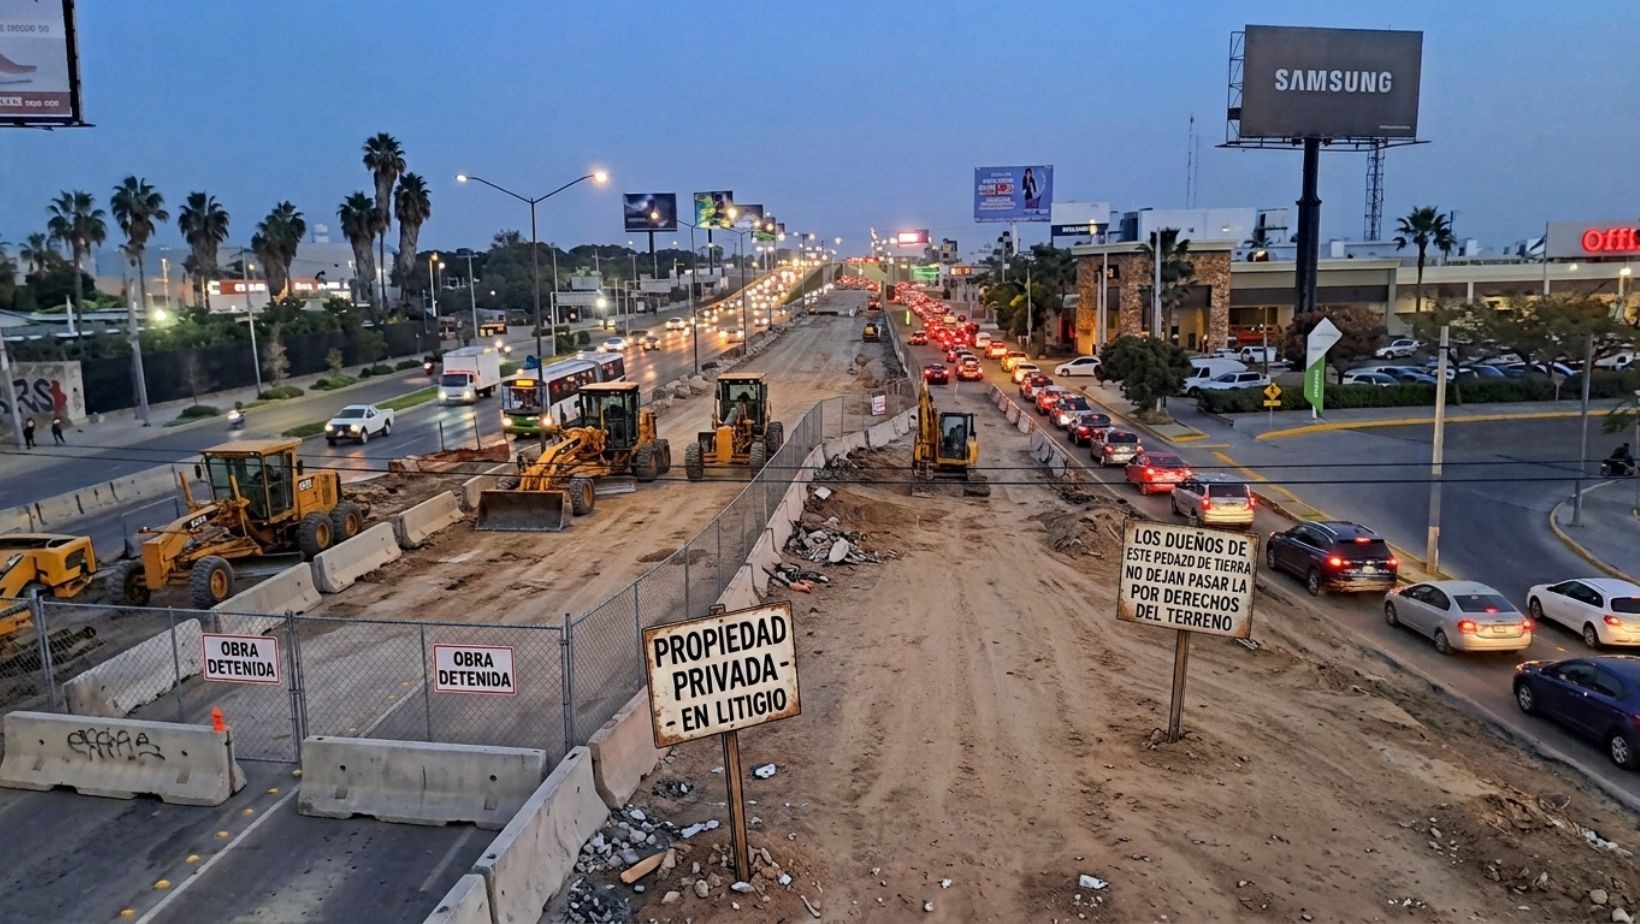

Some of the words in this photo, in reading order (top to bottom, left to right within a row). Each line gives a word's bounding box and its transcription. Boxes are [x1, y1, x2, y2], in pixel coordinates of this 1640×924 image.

[1274, 68, 1393, 93] SAMSUNG
[1135, 528, 1161, 546] LOS
[1165, 531, 1224, 554] DUEÑOS
[1228, 540, 1247, 557] DE
[1127, 547, 1152, 563] ESTE
[1197, 556, 1212, 570] DE
[1215, 558, 1251, 575] TIERRA
[1126, 565, 1143, 580] NO
[1146, 567, 1185, 586] DEJAN
[1189, 572, 1229, 591] PASAR
[1232, 578, 1247, 594] LA
[1131, 584, 1160, 602] POR
[1164, 588, 1240, 612] DERECHOS
[1136, 603, 1162, 621] DEL
[1166, 607, 1232, 631] TERRENO
[221, 641, 259, 657] OBRA
[653, 615, 787, 668] PROPIEDAD
[207, 659, 275, 677] DETENIDA
[453, 651, 494, 668] OBRA
[439, 670, 511, 687] DETENIDA
[681, 703, 709, 732] EN
[716, 688, 787, 724] LITIGIO
